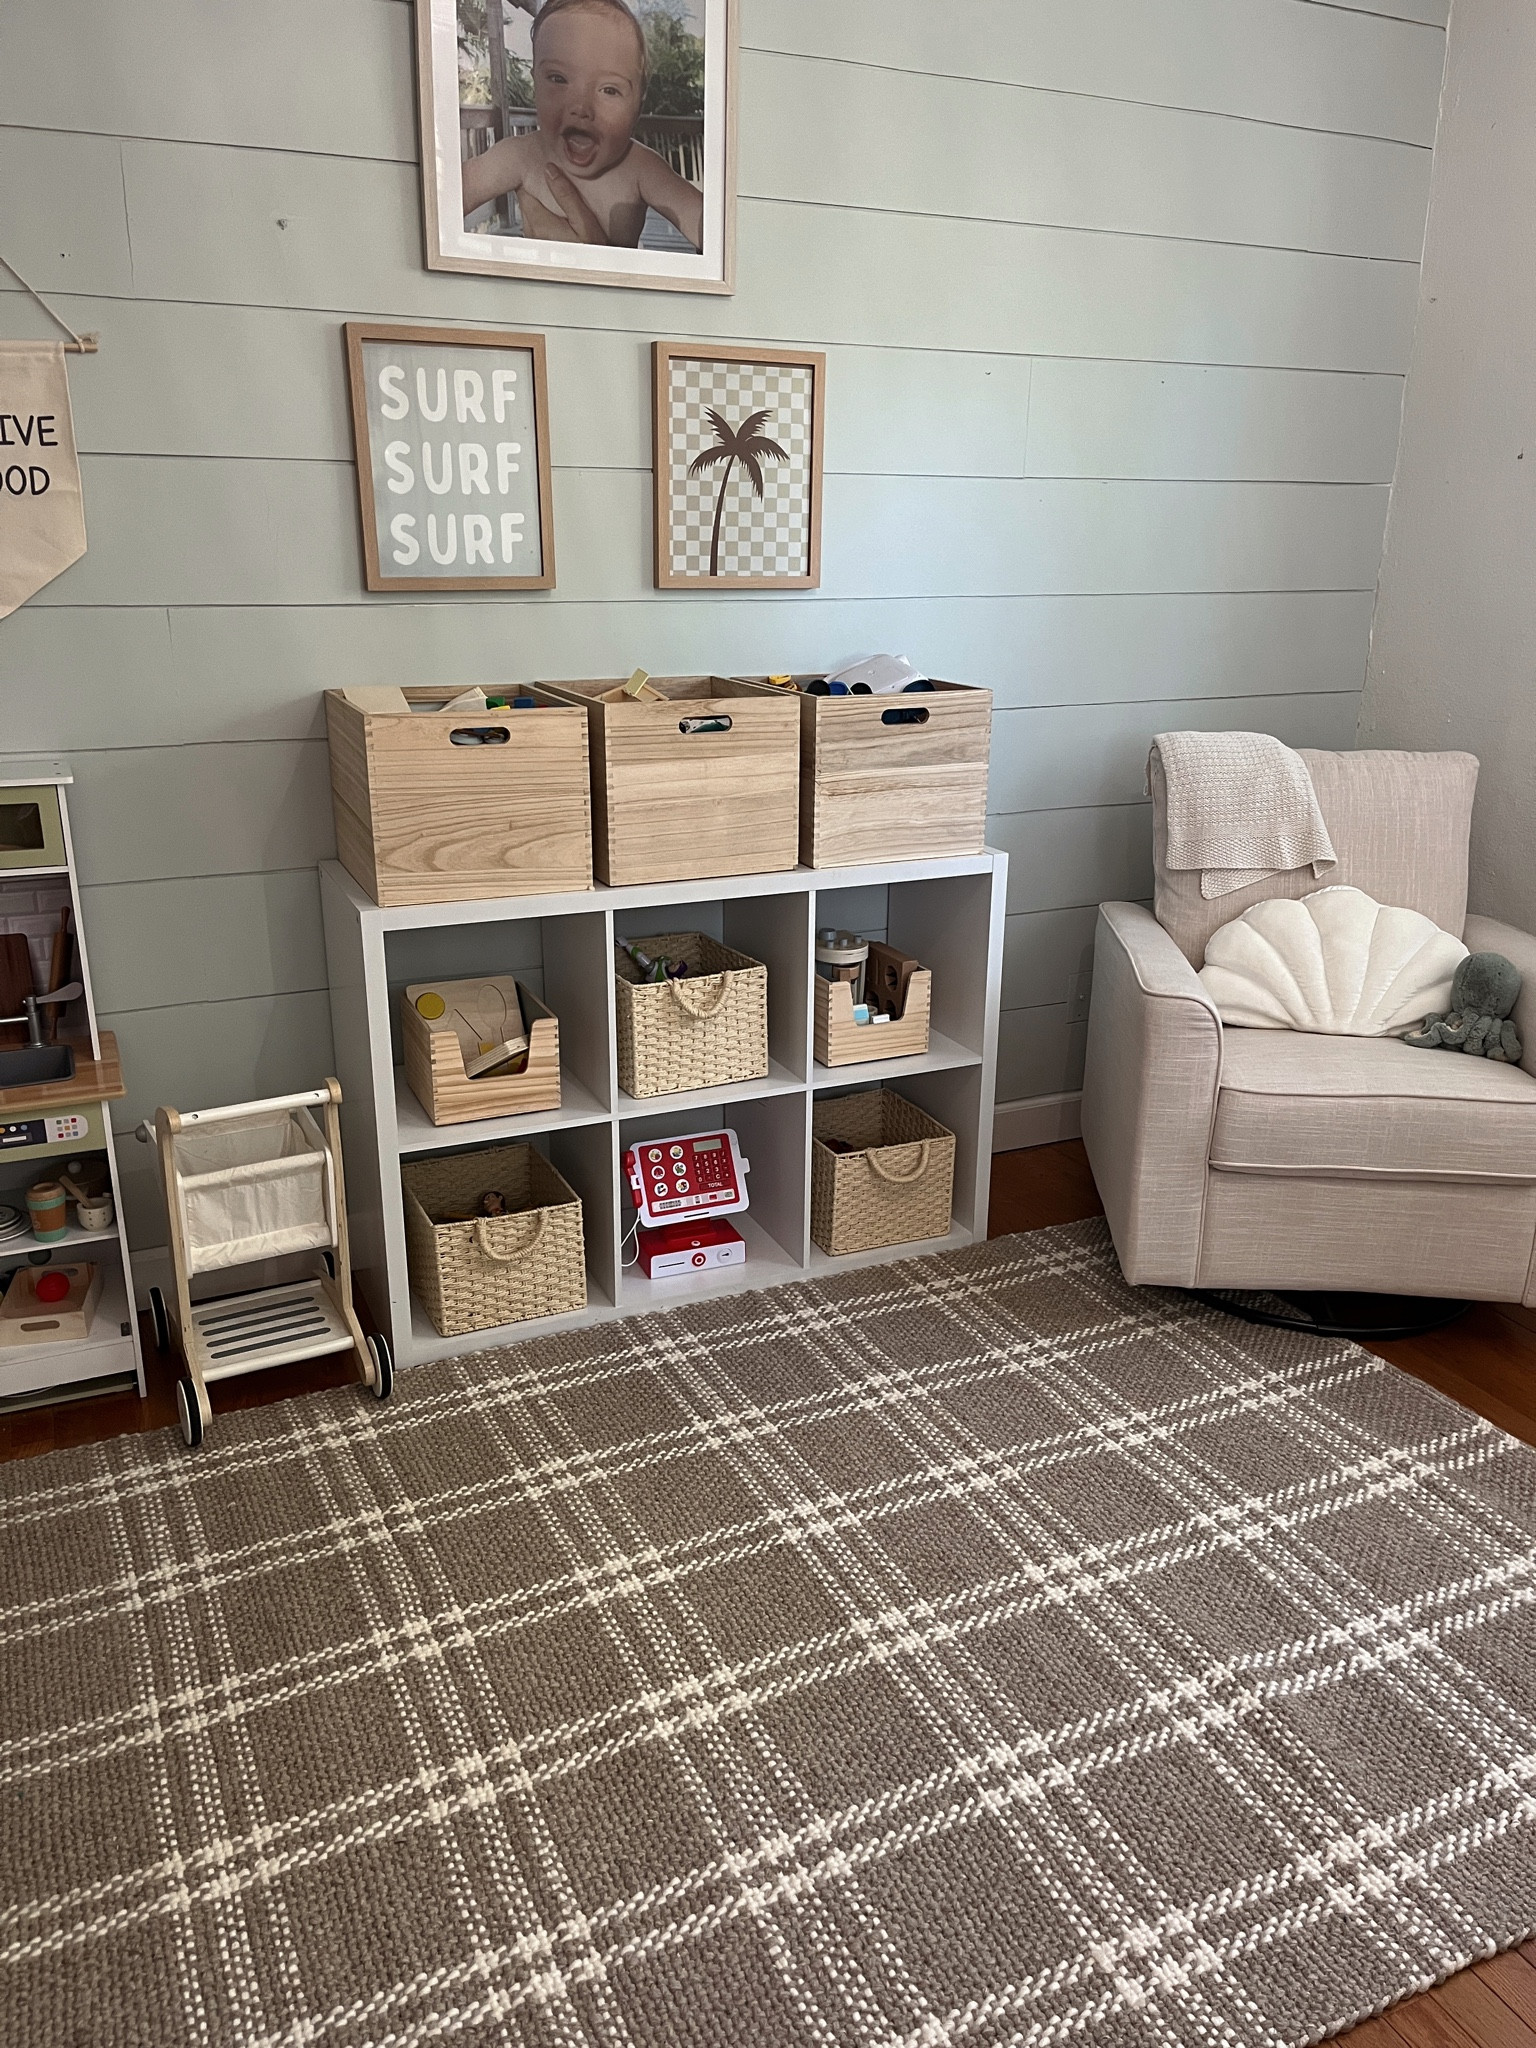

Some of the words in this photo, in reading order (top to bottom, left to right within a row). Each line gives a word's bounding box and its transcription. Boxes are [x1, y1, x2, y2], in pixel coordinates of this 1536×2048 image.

[378, 365, 517, 423] SURF
[0, 465, 50, 495] OD
[384, 440, 521, 495] SURF
[390, 513, 525, 565] SURF
